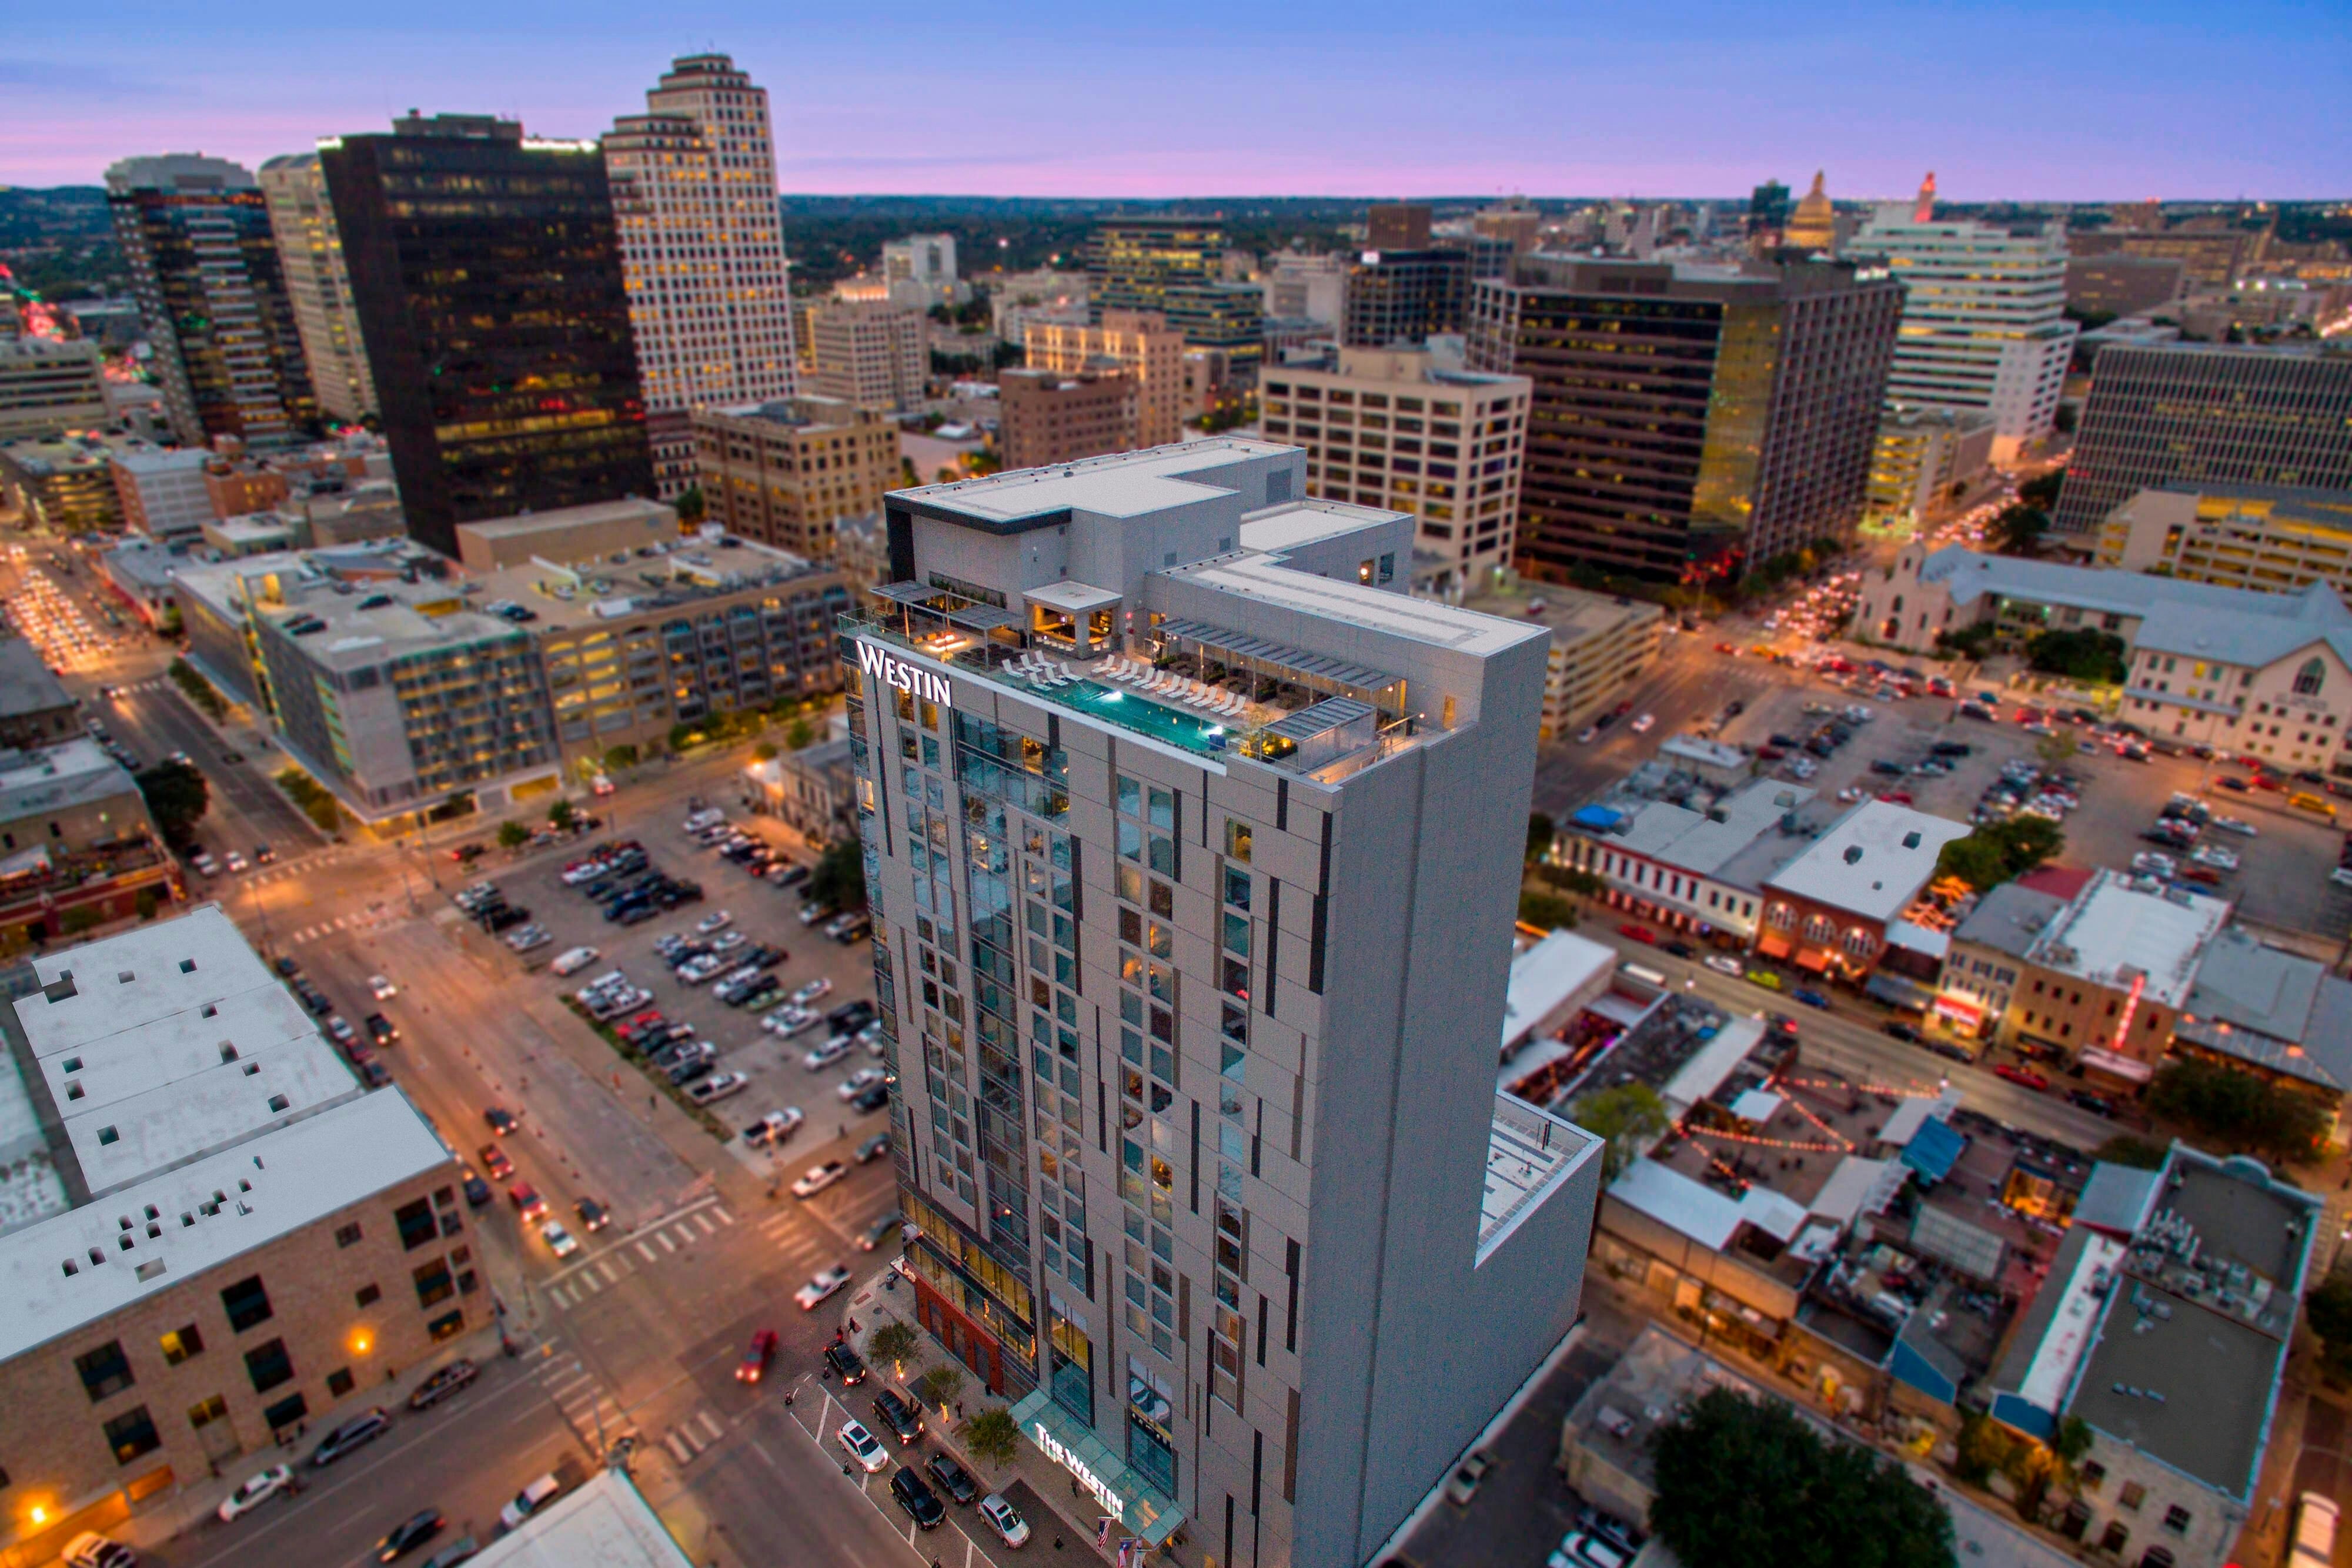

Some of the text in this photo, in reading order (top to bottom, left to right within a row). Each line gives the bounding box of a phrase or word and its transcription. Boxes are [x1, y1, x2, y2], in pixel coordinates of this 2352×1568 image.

[856, 640, 951, 708] WESTIN
[1035, 1422, 1123, 1513] THE WESTIN
